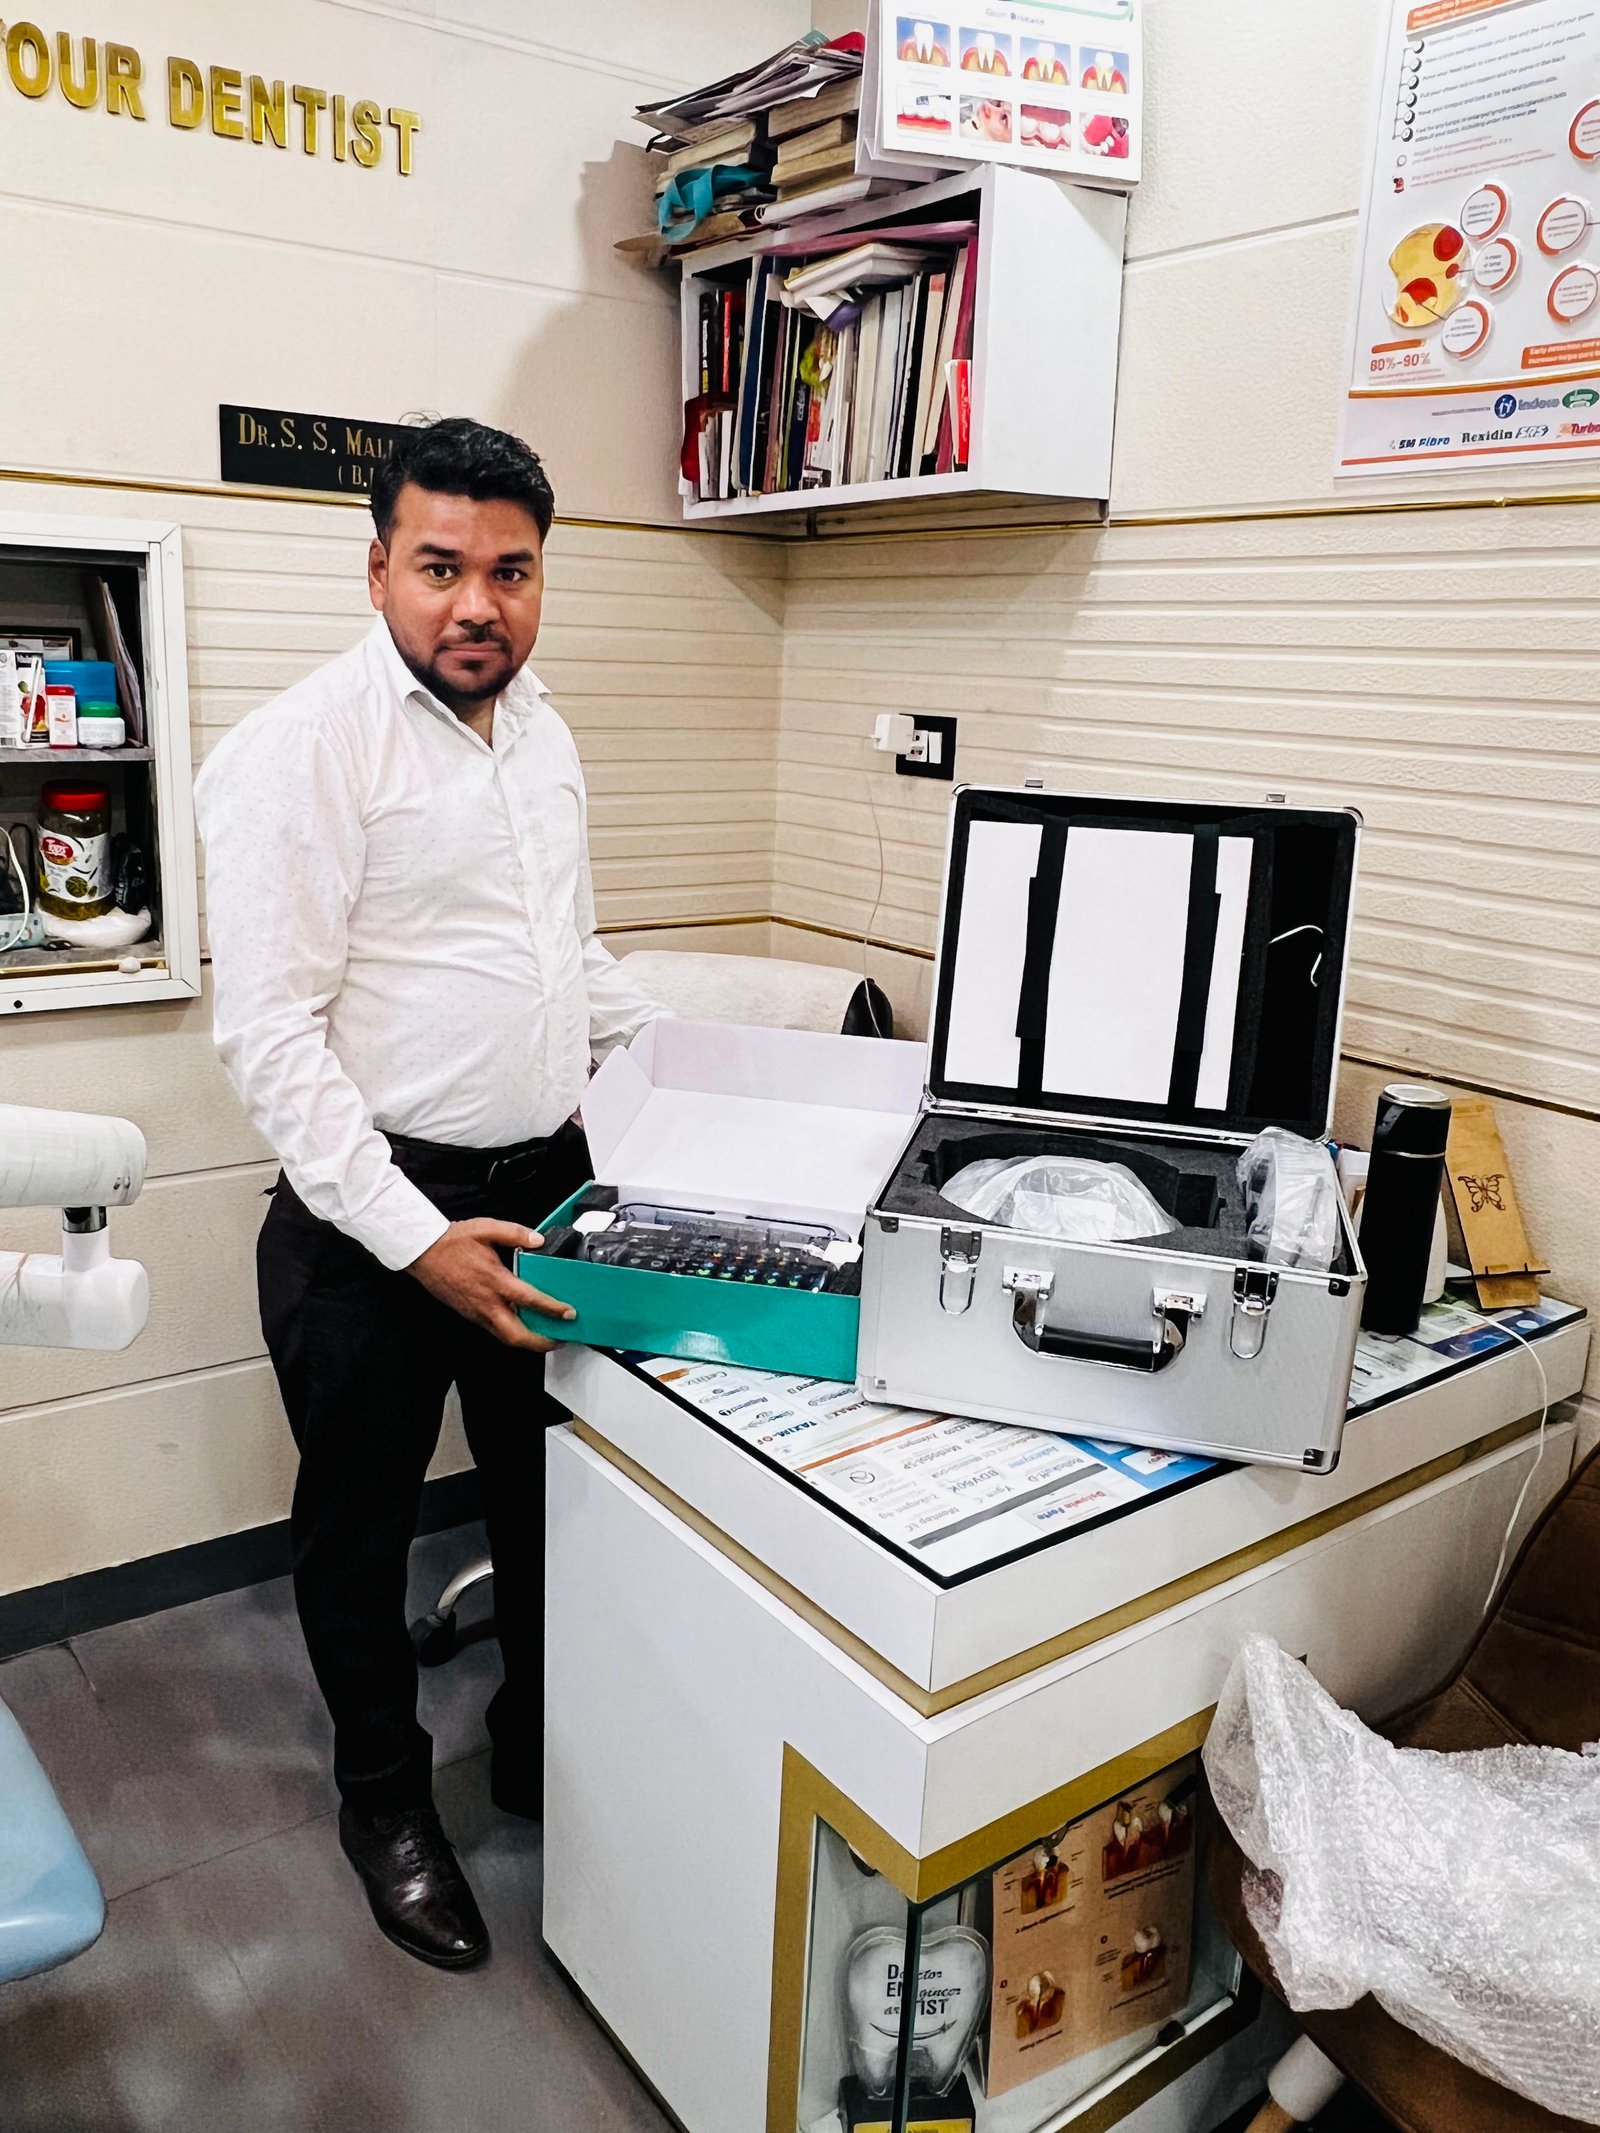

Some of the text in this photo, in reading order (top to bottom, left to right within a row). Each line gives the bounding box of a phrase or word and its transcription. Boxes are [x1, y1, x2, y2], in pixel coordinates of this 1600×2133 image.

[0, 20, 421, 176] OUR DENTIST
[1370, 352, 1431, 372] 80%-90%
[1461, 429, 1513, 443] Rexidin
